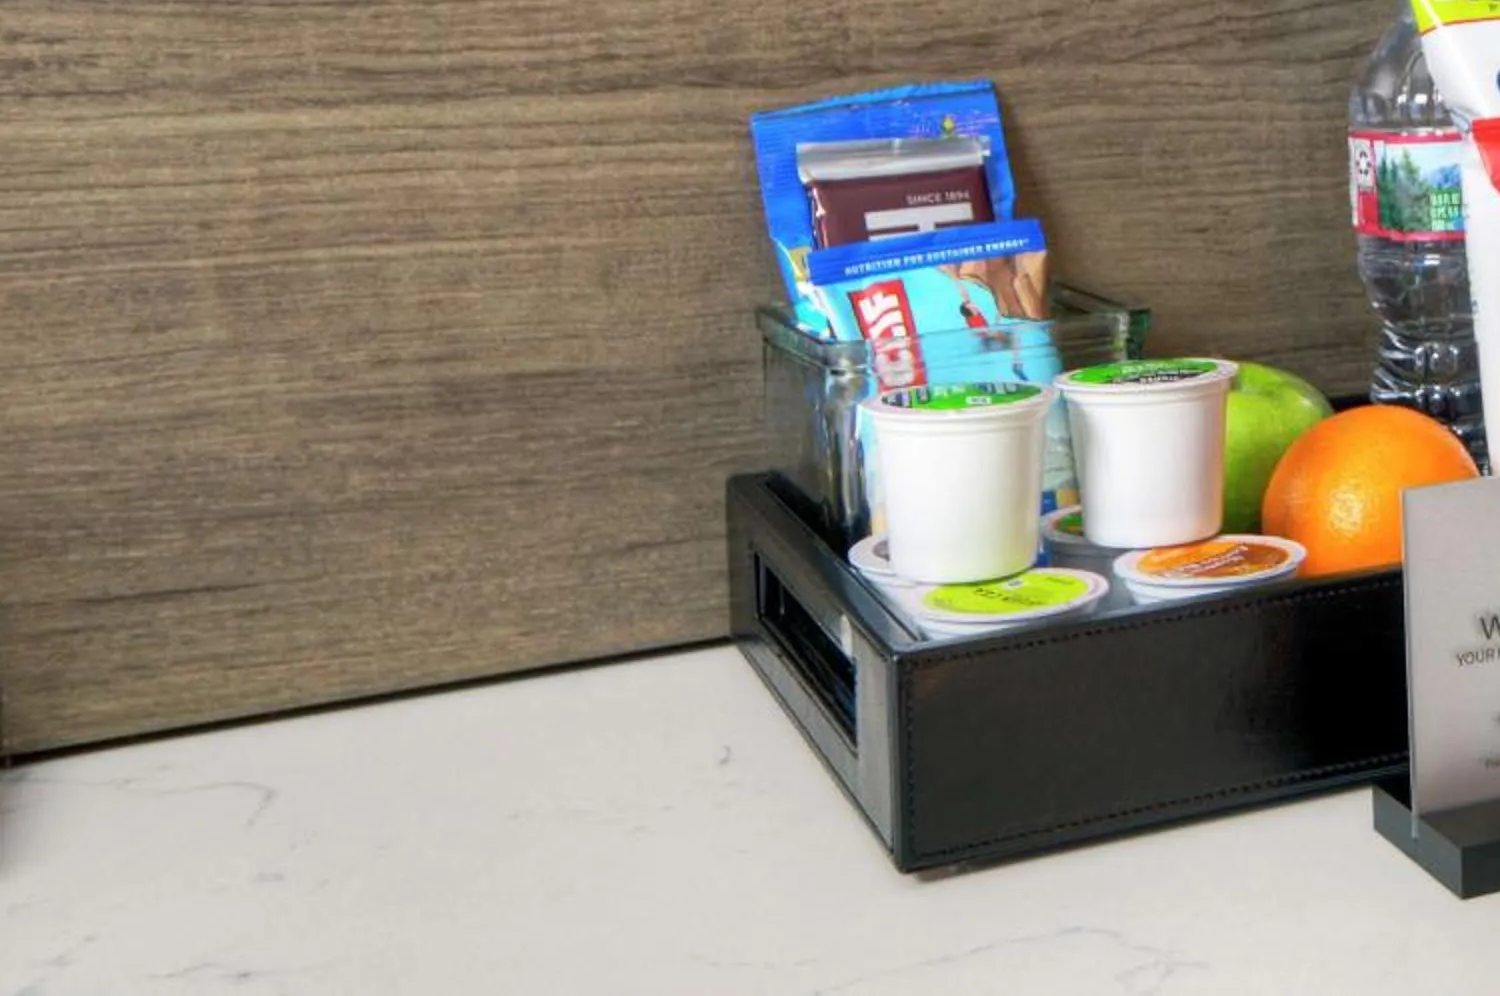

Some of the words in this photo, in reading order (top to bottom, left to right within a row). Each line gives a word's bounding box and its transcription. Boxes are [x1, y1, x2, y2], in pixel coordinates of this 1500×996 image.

[906, 192, 941, 204] SINCE
[845, 258, 900, 276] NUTRITION
[903, 254, 924, 267] FOR
[927, 245, 983, 262] SUSTAINED
[859, 290, 916, 387] CLIF
[1456, 648, 1494, 667] YOUR
